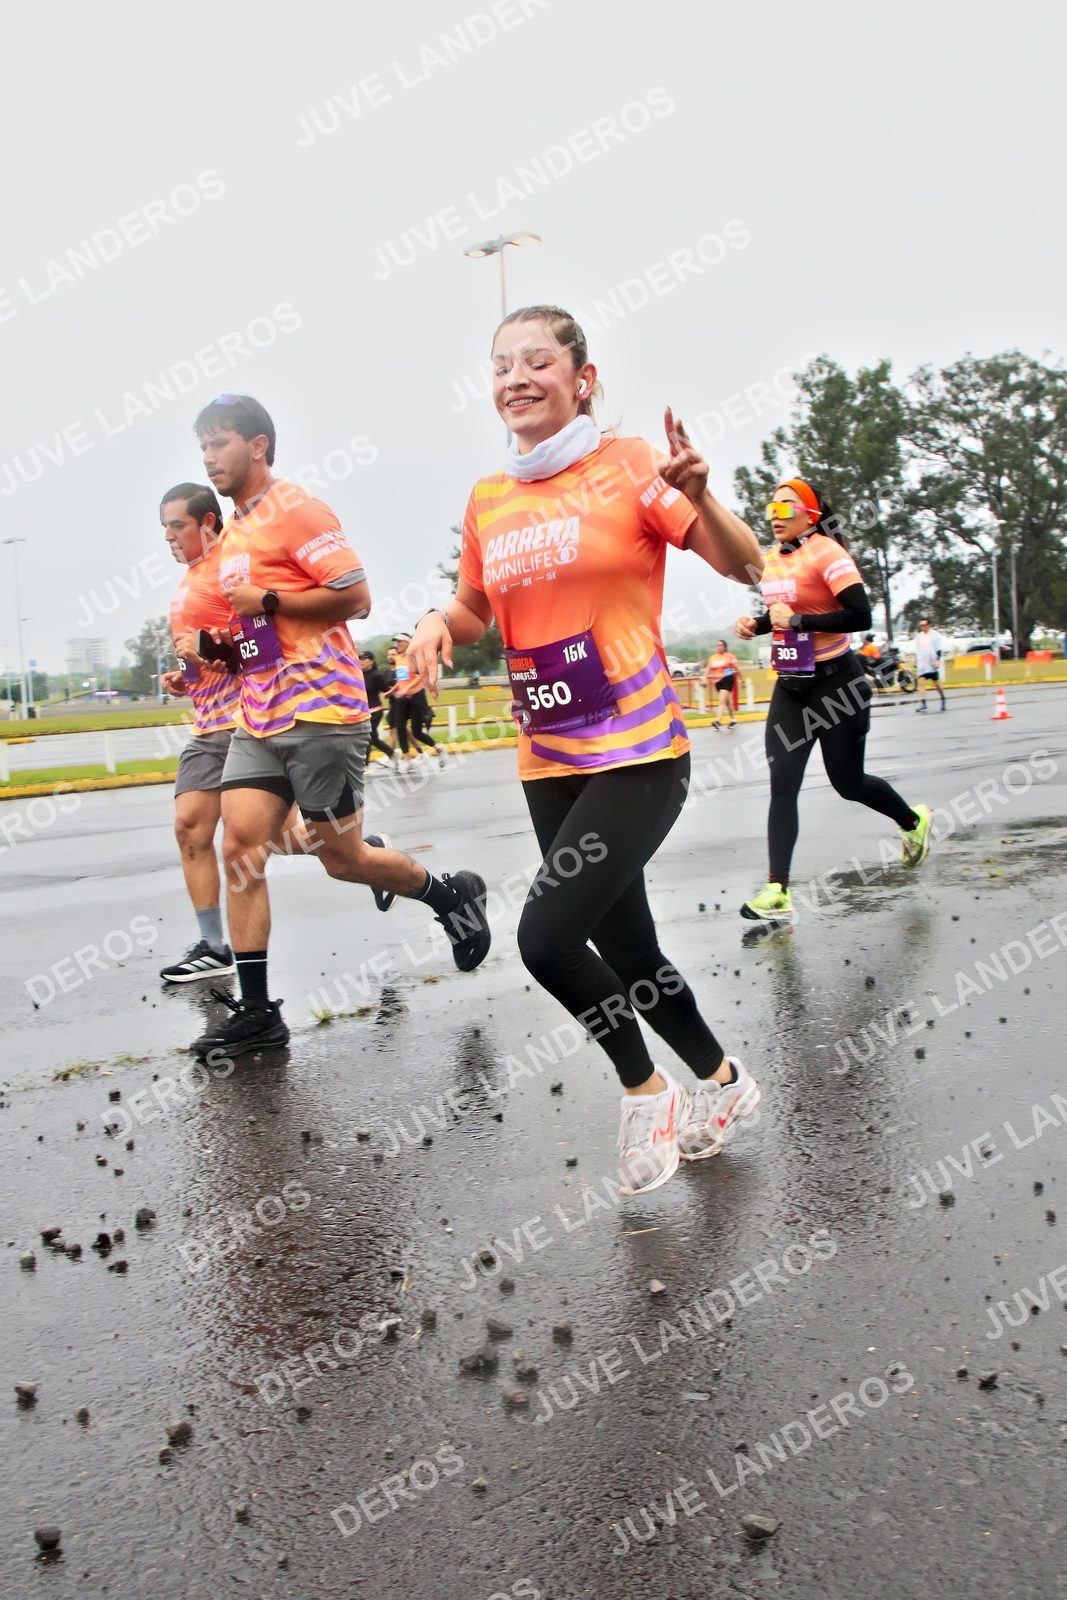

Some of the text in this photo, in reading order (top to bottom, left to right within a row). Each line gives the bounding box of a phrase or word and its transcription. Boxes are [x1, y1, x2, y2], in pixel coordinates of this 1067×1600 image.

[485, 516, 580, 566] CARRERA
[484, 550, 552, 587] OMNILIFE
[253, 614, 268, 629] 15K
[240, 639, 259, 660] 625
[562, 640, 588, 664] 15K
[777, 647, 798, 660] 303
[526, 680, 572, 711] 560
